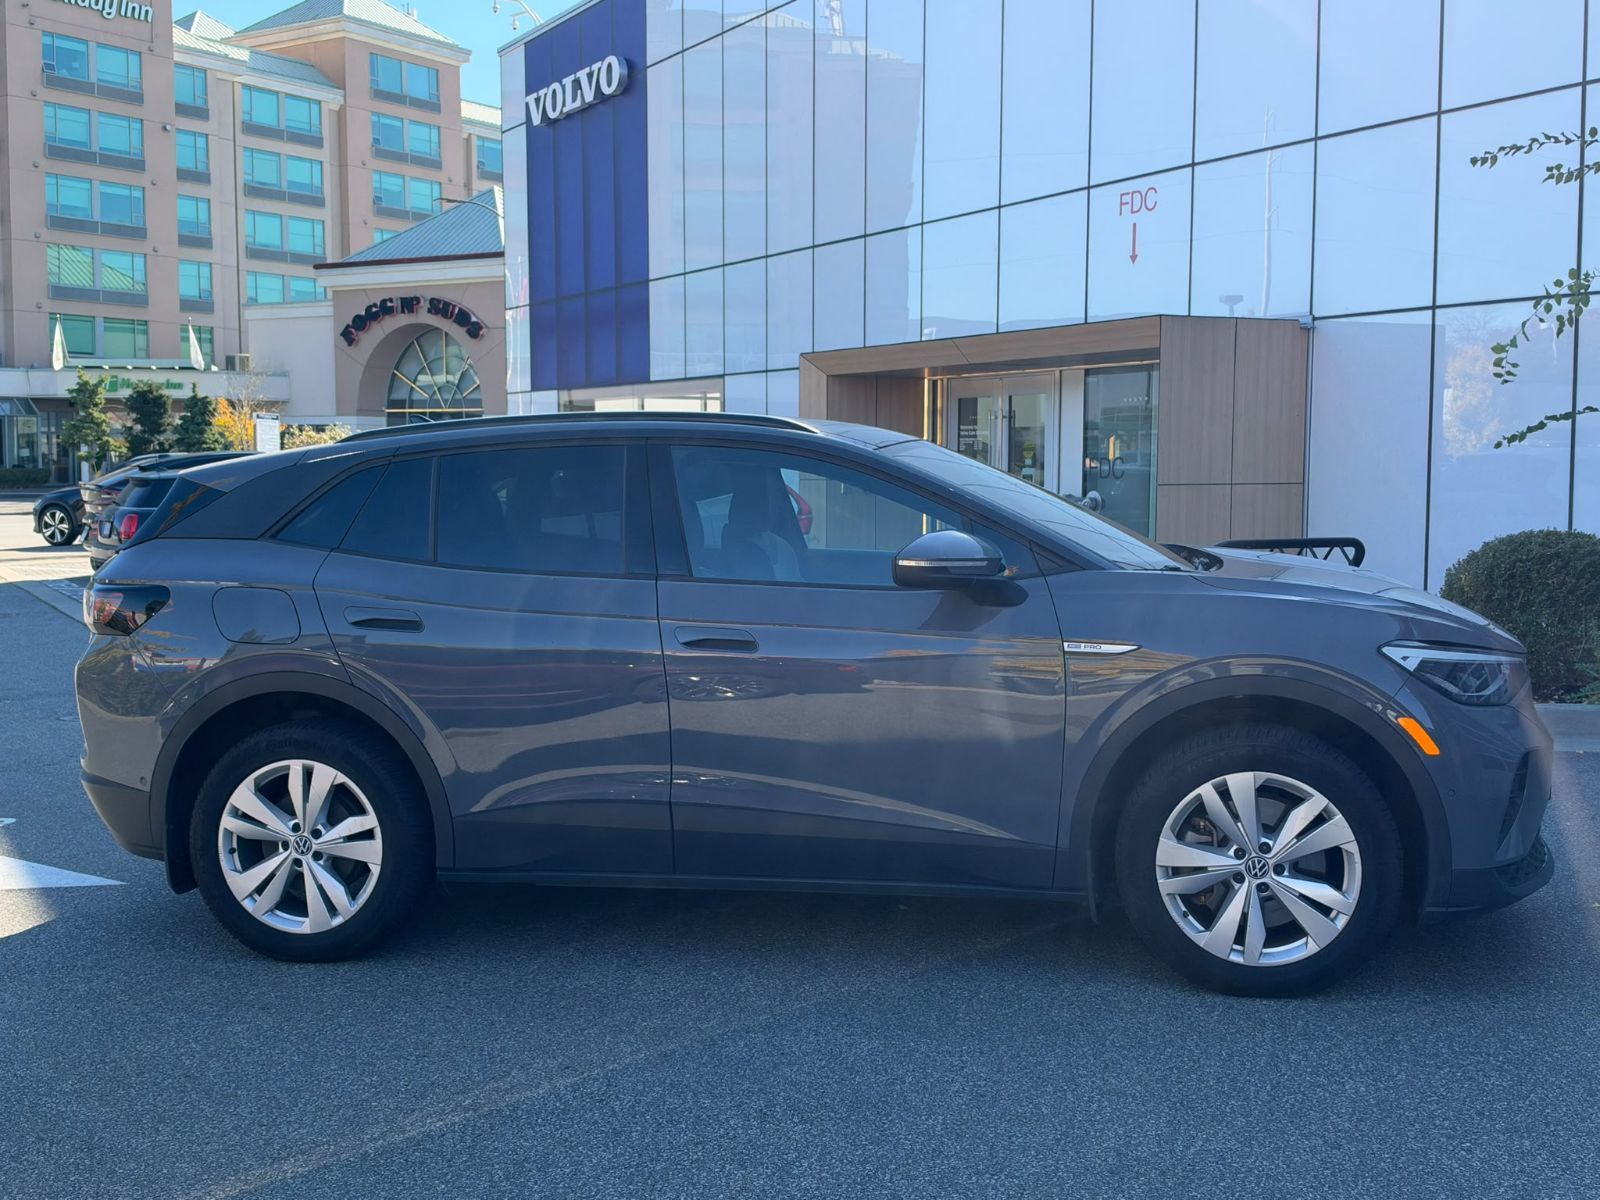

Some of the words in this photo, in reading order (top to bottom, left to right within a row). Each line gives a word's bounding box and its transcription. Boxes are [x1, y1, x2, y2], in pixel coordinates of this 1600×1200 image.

[119, 0, 153, 23] Inn
[525, 55, 625, 127] VOLVO
[1119, 187, 1157, 216] FDC
[427, 297, 485, 340] SUDS
